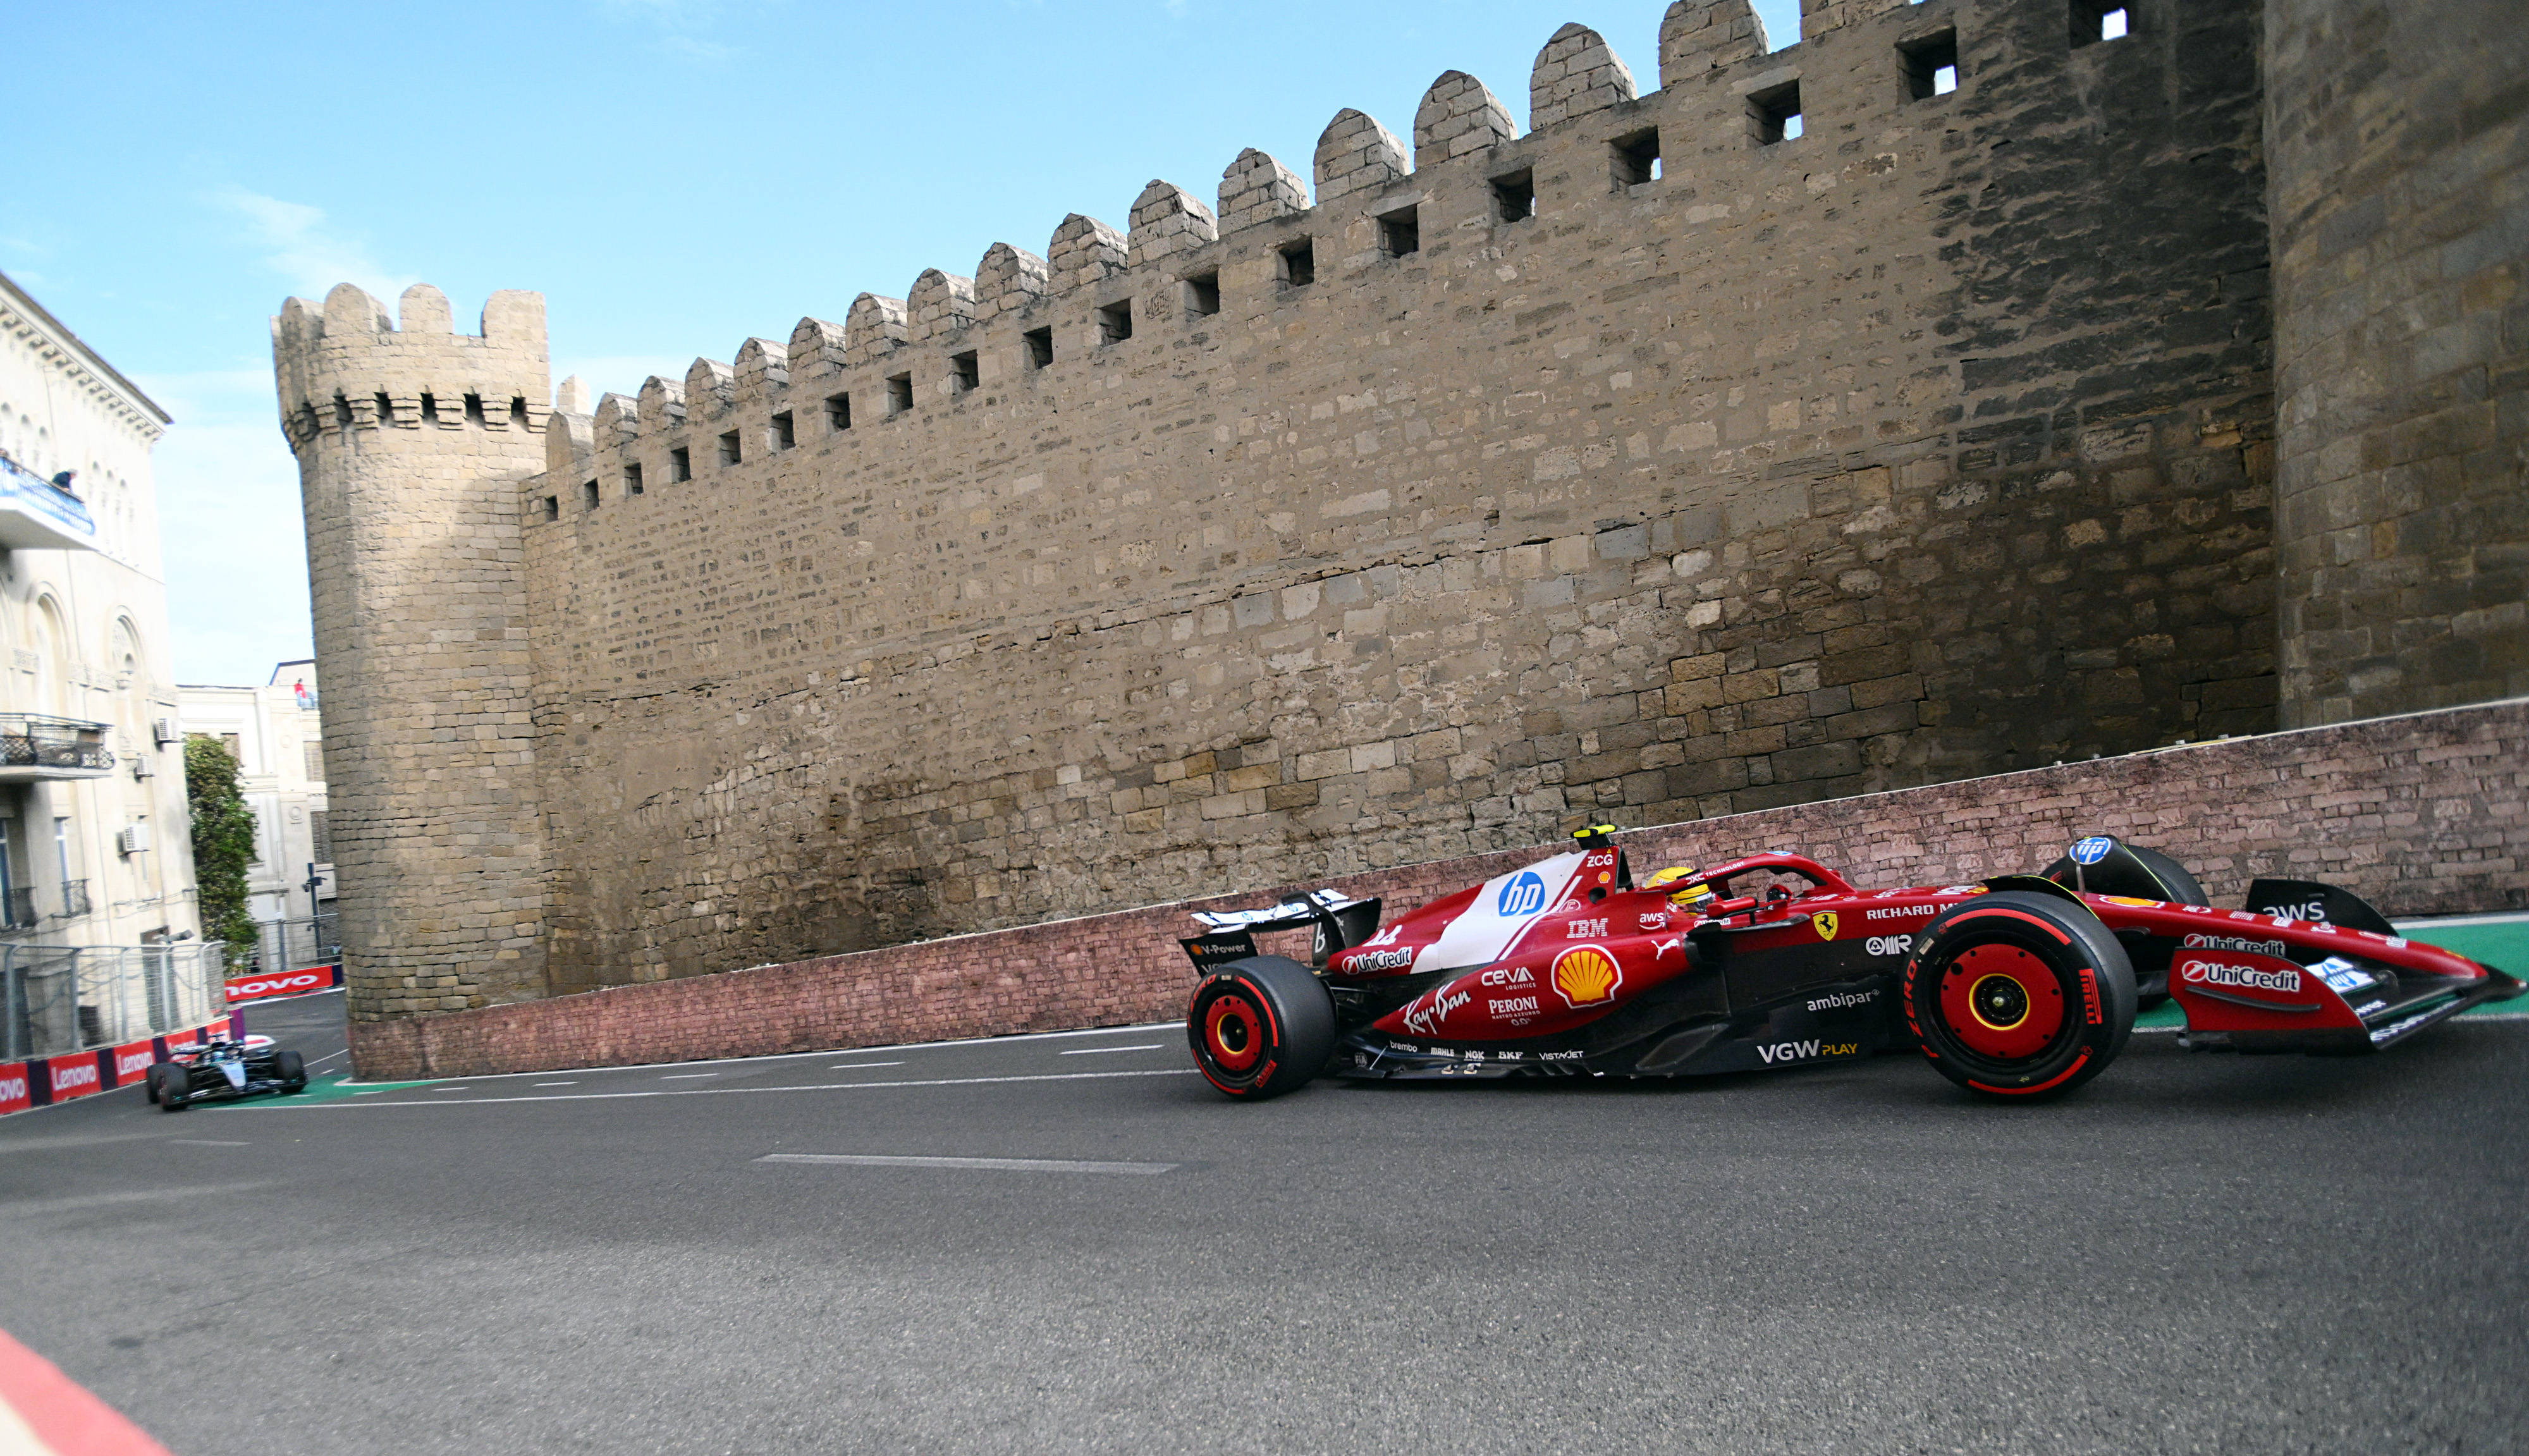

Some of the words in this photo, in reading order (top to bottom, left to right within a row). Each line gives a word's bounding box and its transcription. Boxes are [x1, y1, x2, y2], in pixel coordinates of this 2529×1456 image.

[2074, 838, 2107, 864] hp
[1586, 853, 1614, 867] ZCG
[1705, 861, 1745, 877] TECHNOLOGY
[1500, 872, 1543, 915] hp
[1639, 912, 1664, 923] aws
[1866, 904, 1934, 920] RICHARD
[1566, 917, 1608, 938] IBM
[1201, 944, 1246, 955] V-Power
[1356, 946, 1412, 972] UniCredit
[2207, 964, 2299, 992] UniCredit
[1505, 982, 1536, 991] LOGISTICS
[1488, 996, 1538, 1014] PERONI
[1807, 993, 1871, 1011] ambipar
[1390, 1040, 1418, 1053] brembo
[1430, 1047, 1455, 1057] MAHLE
[1756, 1039, 1820, 1063] VGW
[1822, 1043, 1858, 1056] PLAY
[116, 1051, 153, 1075] Lenovo
[1354, 1053, 1368, 1067] FIA
[1465, 1050, 1485, 1060] NGK
[1498, 1051, 1524, 1060] SKF
[51, 1065, 97, 1091] Lenovo
